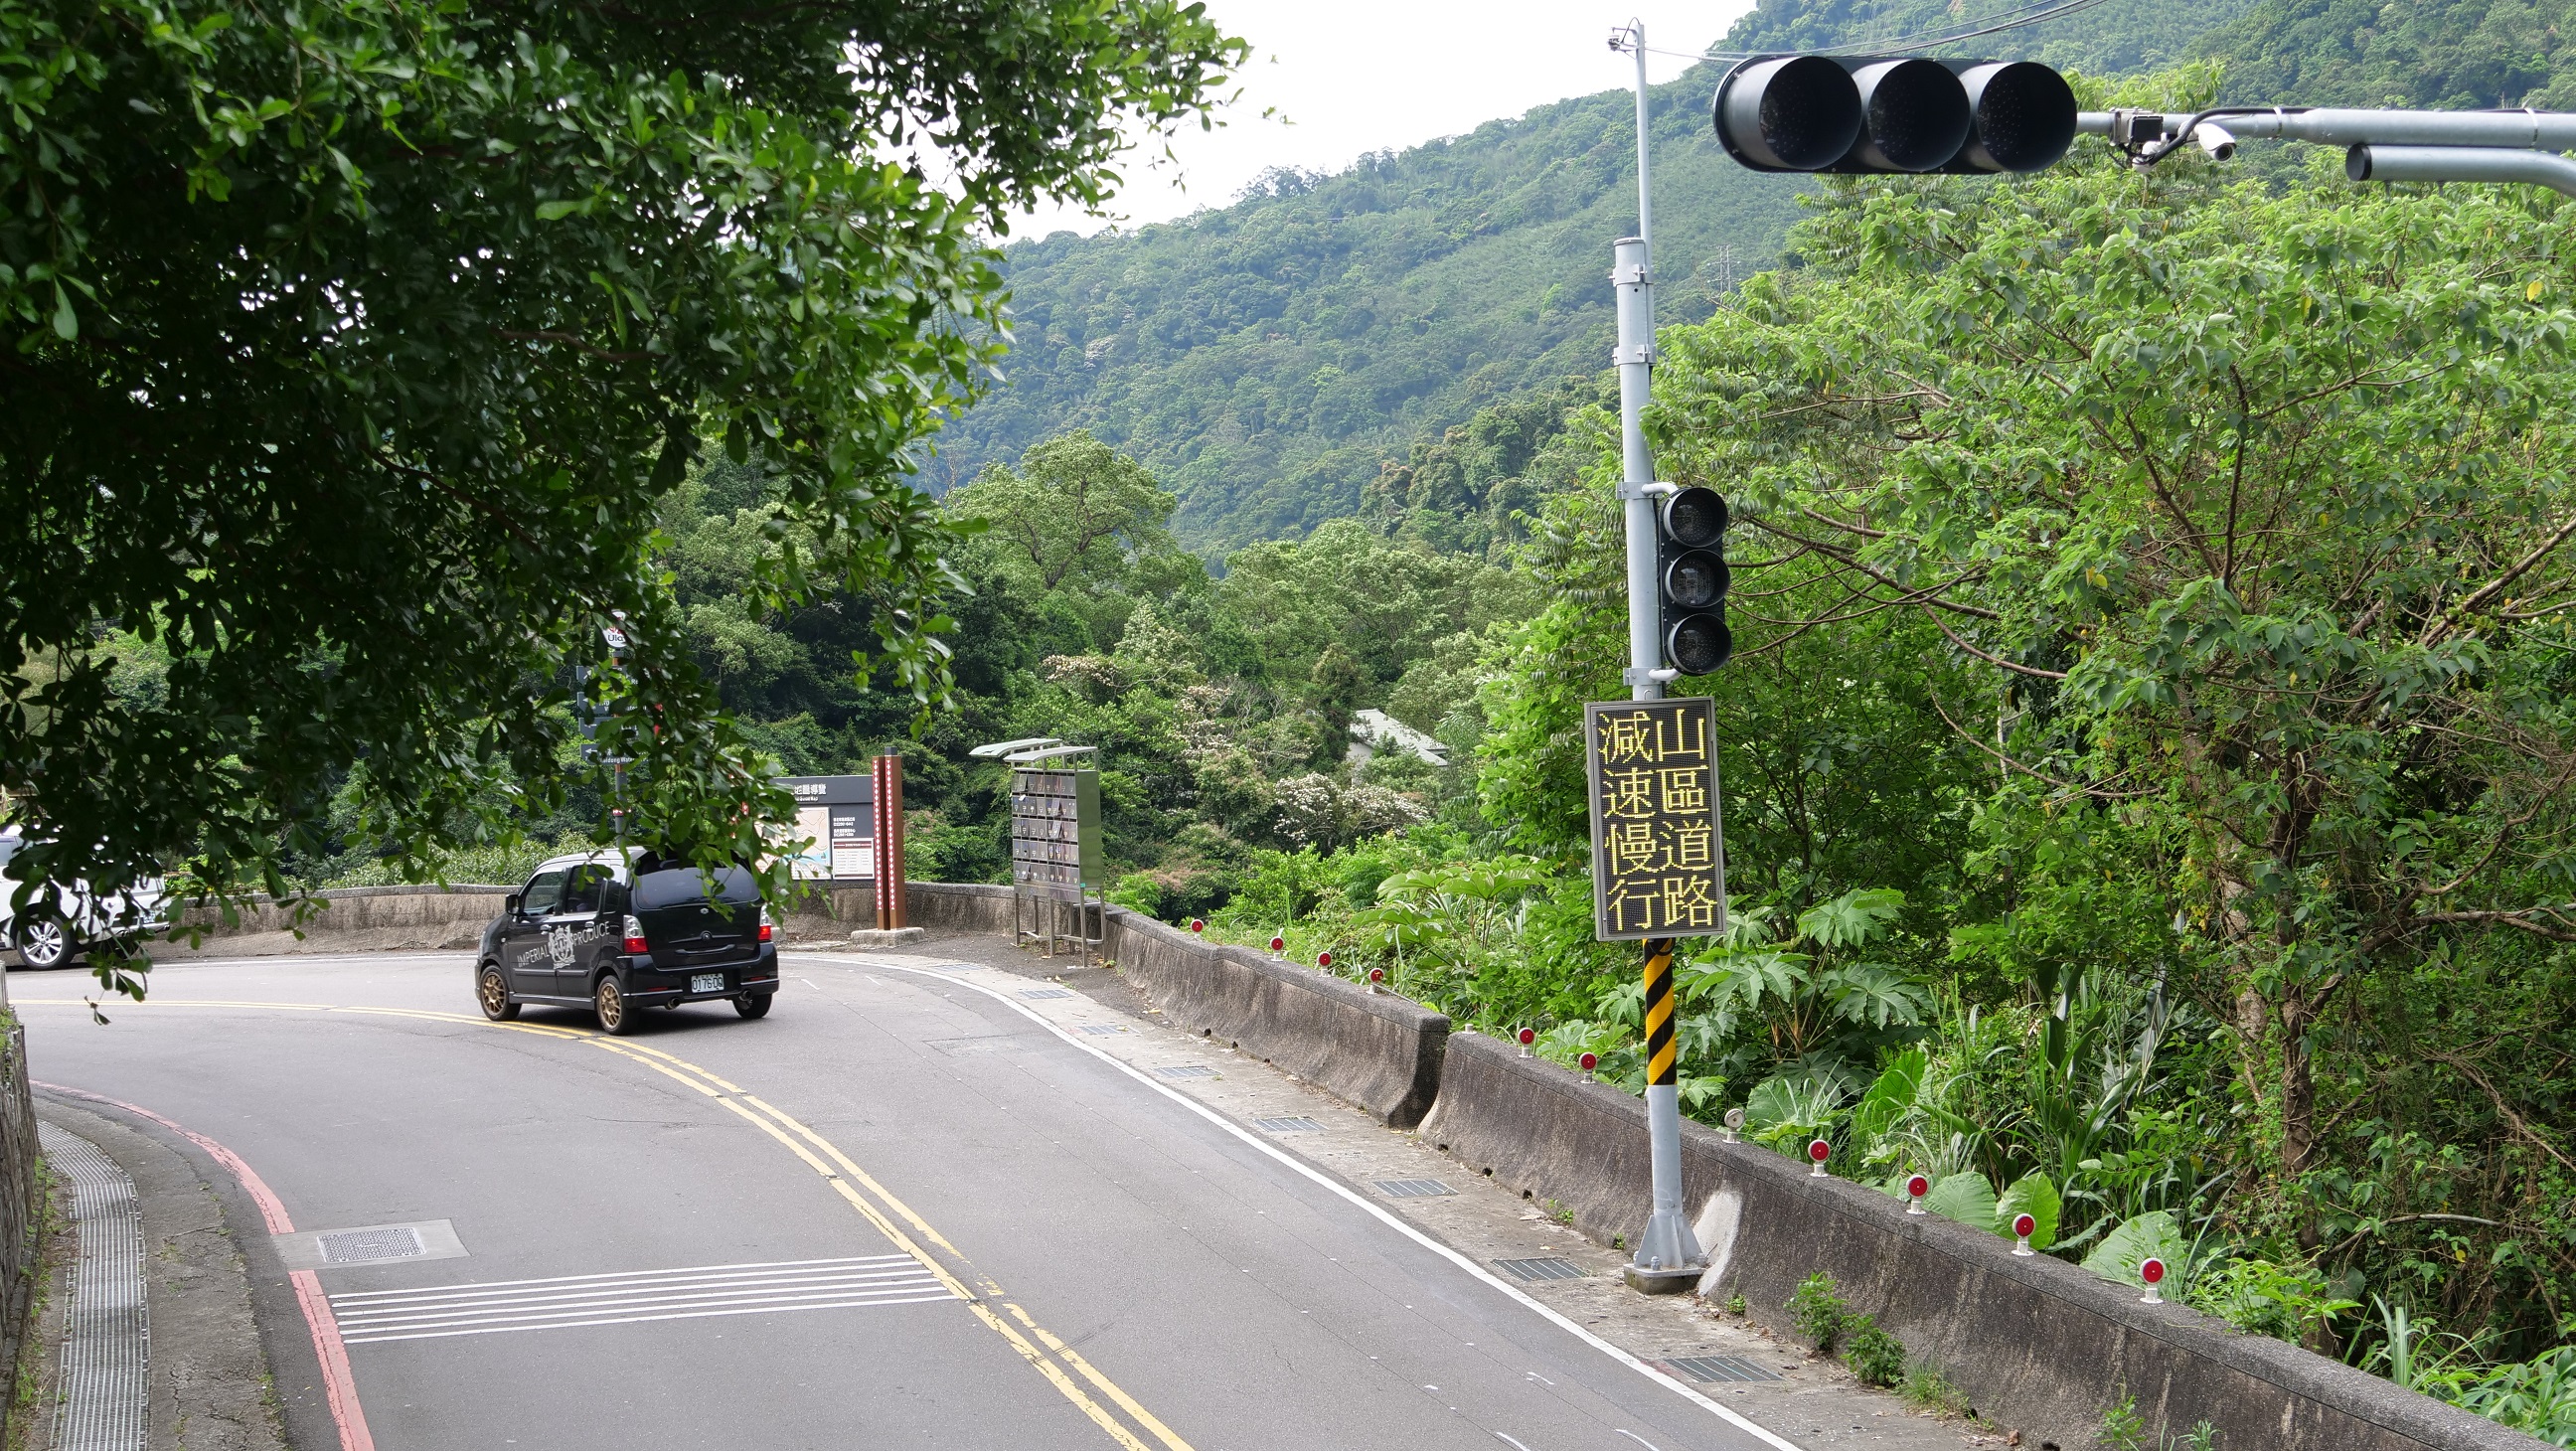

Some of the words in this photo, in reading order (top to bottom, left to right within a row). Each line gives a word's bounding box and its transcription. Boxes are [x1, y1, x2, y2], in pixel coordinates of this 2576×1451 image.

[1597, 711, 1661, 931] 減速慢行
[1656, 709, 1717, 927] 山區道路
[517, 943, 551, 968] IMPERIAL
[573, 921, 610, 947] PRODUCE
